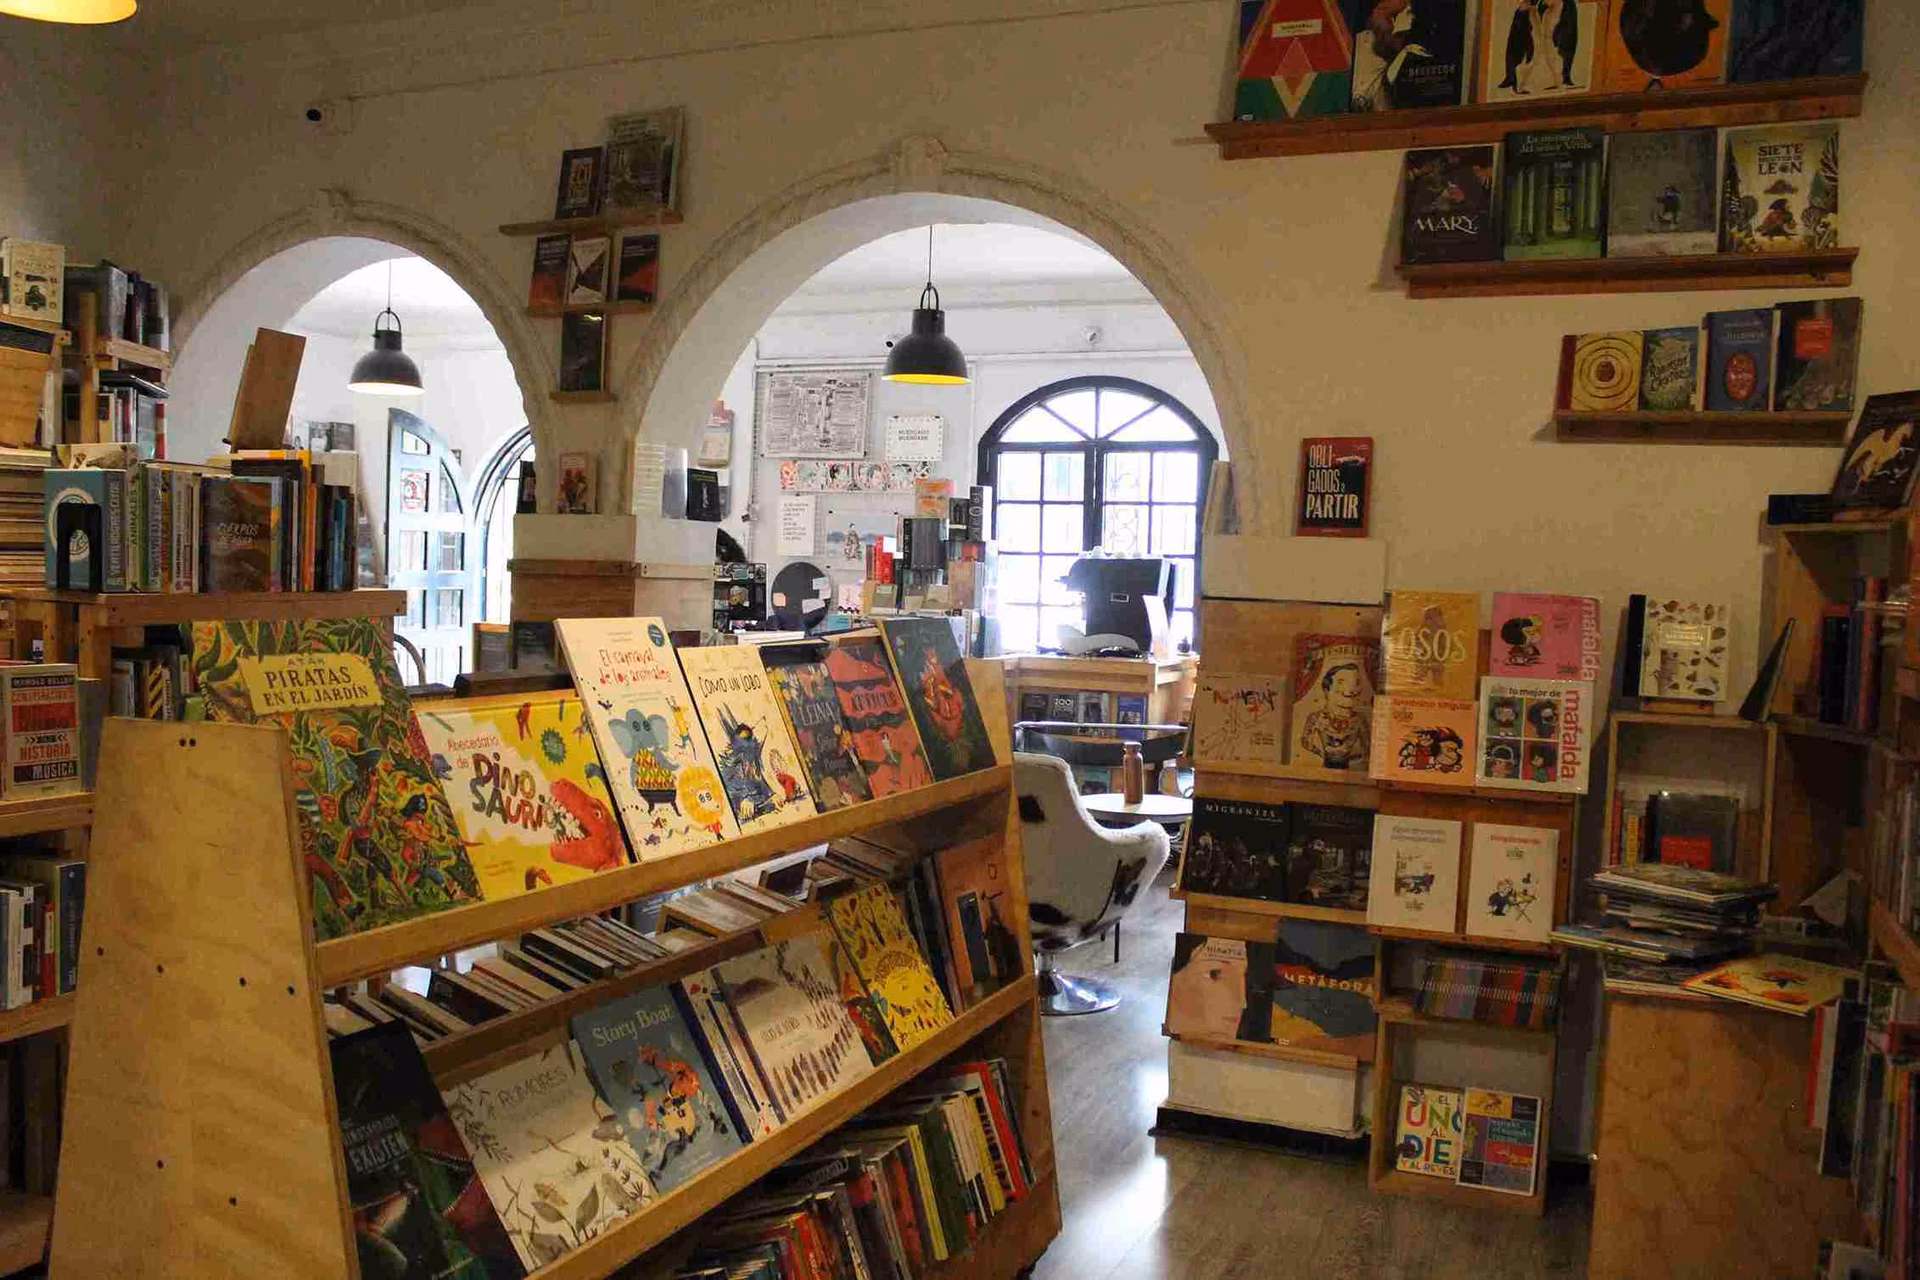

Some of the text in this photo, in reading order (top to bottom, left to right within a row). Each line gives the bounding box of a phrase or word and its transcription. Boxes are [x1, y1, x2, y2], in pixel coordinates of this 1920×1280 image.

[1306, 493, 1359, 519] PARTIR
[1401, 627, 1467, 663] OSOS
[265, 666, 351, 689] PIRATAS
[699, 676, 728, 698] COMO
[262, 684, 369, 707] EN EL JARDÍN
[1561, 689, 1583, 779] mafalda
[20, 743, 70, 760] HISTORIA
[456, 757, 470, 769] de
[592, 1003, 674, 1047] Story Boat
[1438, 1094, 1451, 1105] EL
[1431, 1127, 1446, 1139] AL
